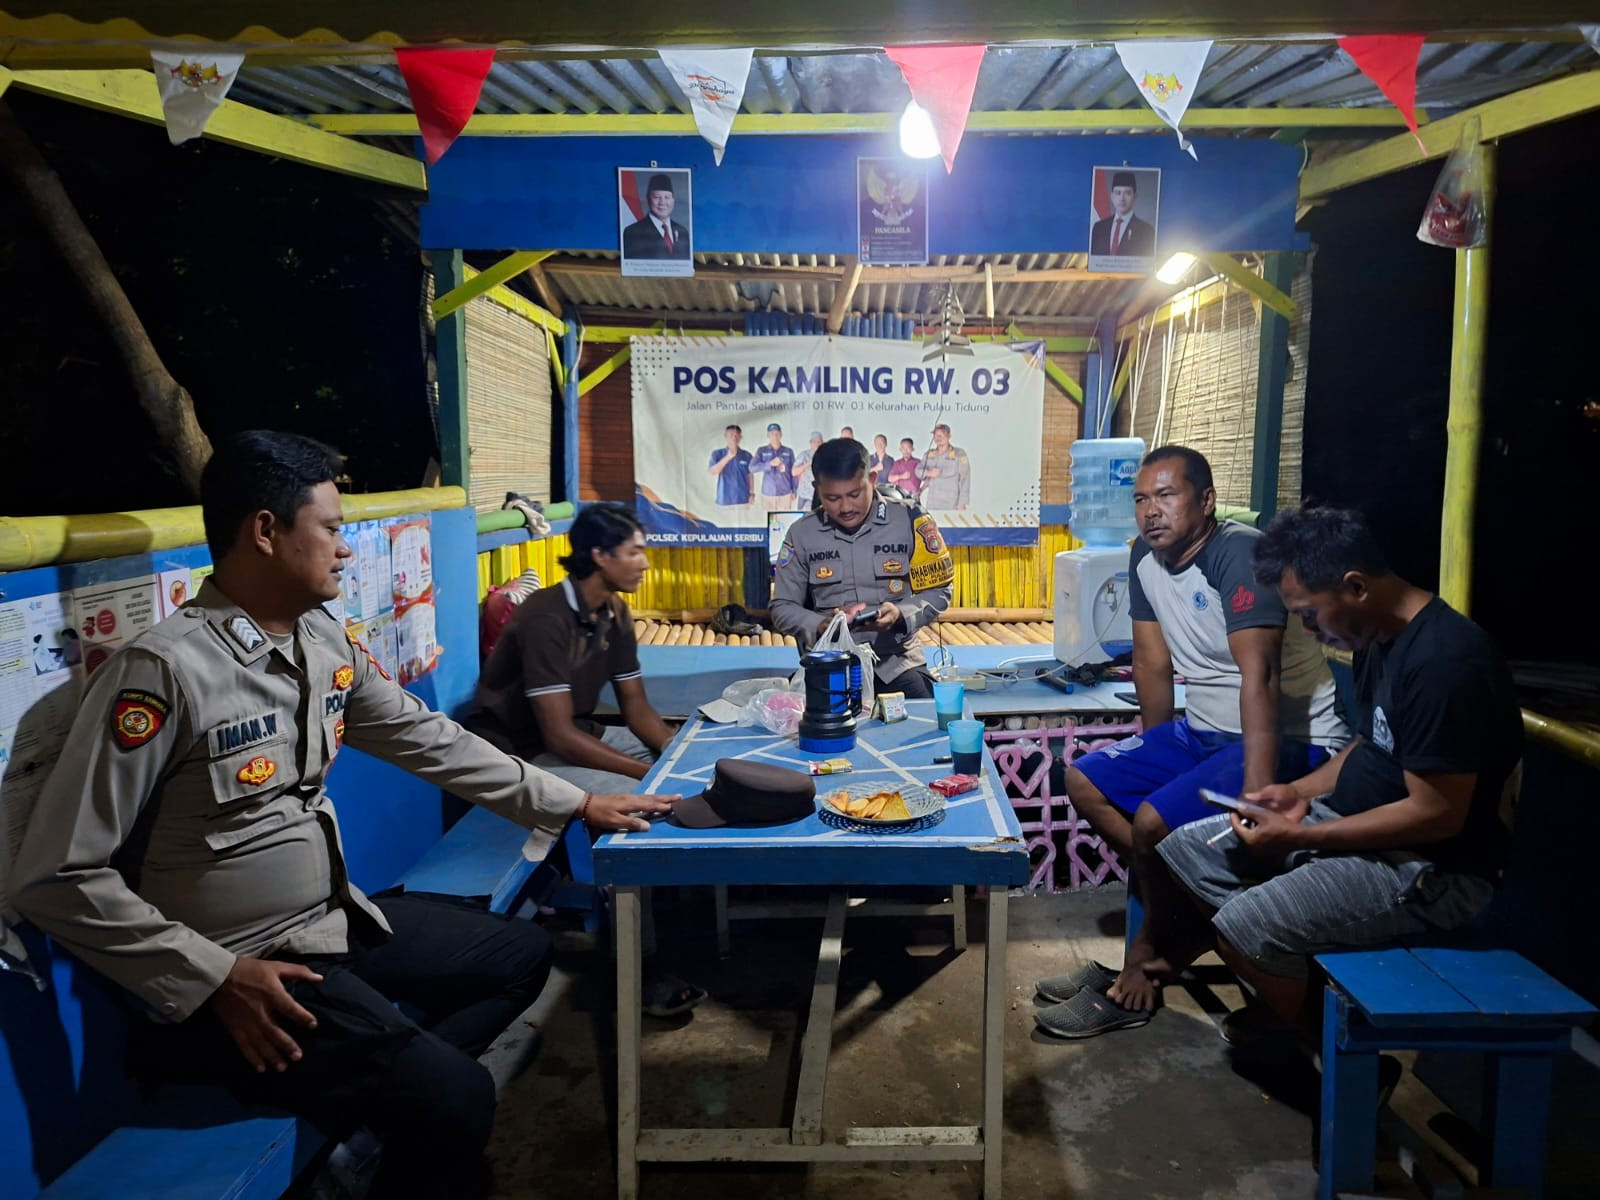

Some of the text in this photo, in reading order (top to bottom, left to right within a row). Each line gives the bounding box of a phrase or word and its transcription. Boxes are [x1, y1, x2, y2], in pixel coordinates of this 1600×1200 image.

[673, 366, 1010, 396] POS KAMLING RW. 03
[686, 402, 712, 411] Jalan
[716, 402, 747, 411] Pantai
[752, 402, 788, 411] Selatan
[812, 401, 824, 411] 01
[851, 402, 864, 411] 03
[868, 403, 919, 412] Kelurahan
[924, 403, 951, 412] Pulau
[955, 403, 990, 413] Tidung
[646, 533, 764, 542] POLSEK KEPULAUAN SERIBU
[873, 544, 908, 554] POLRI
[809, 550, 841, 562] ANDIKA
[216, 713, 277, 752] IMAN.W
